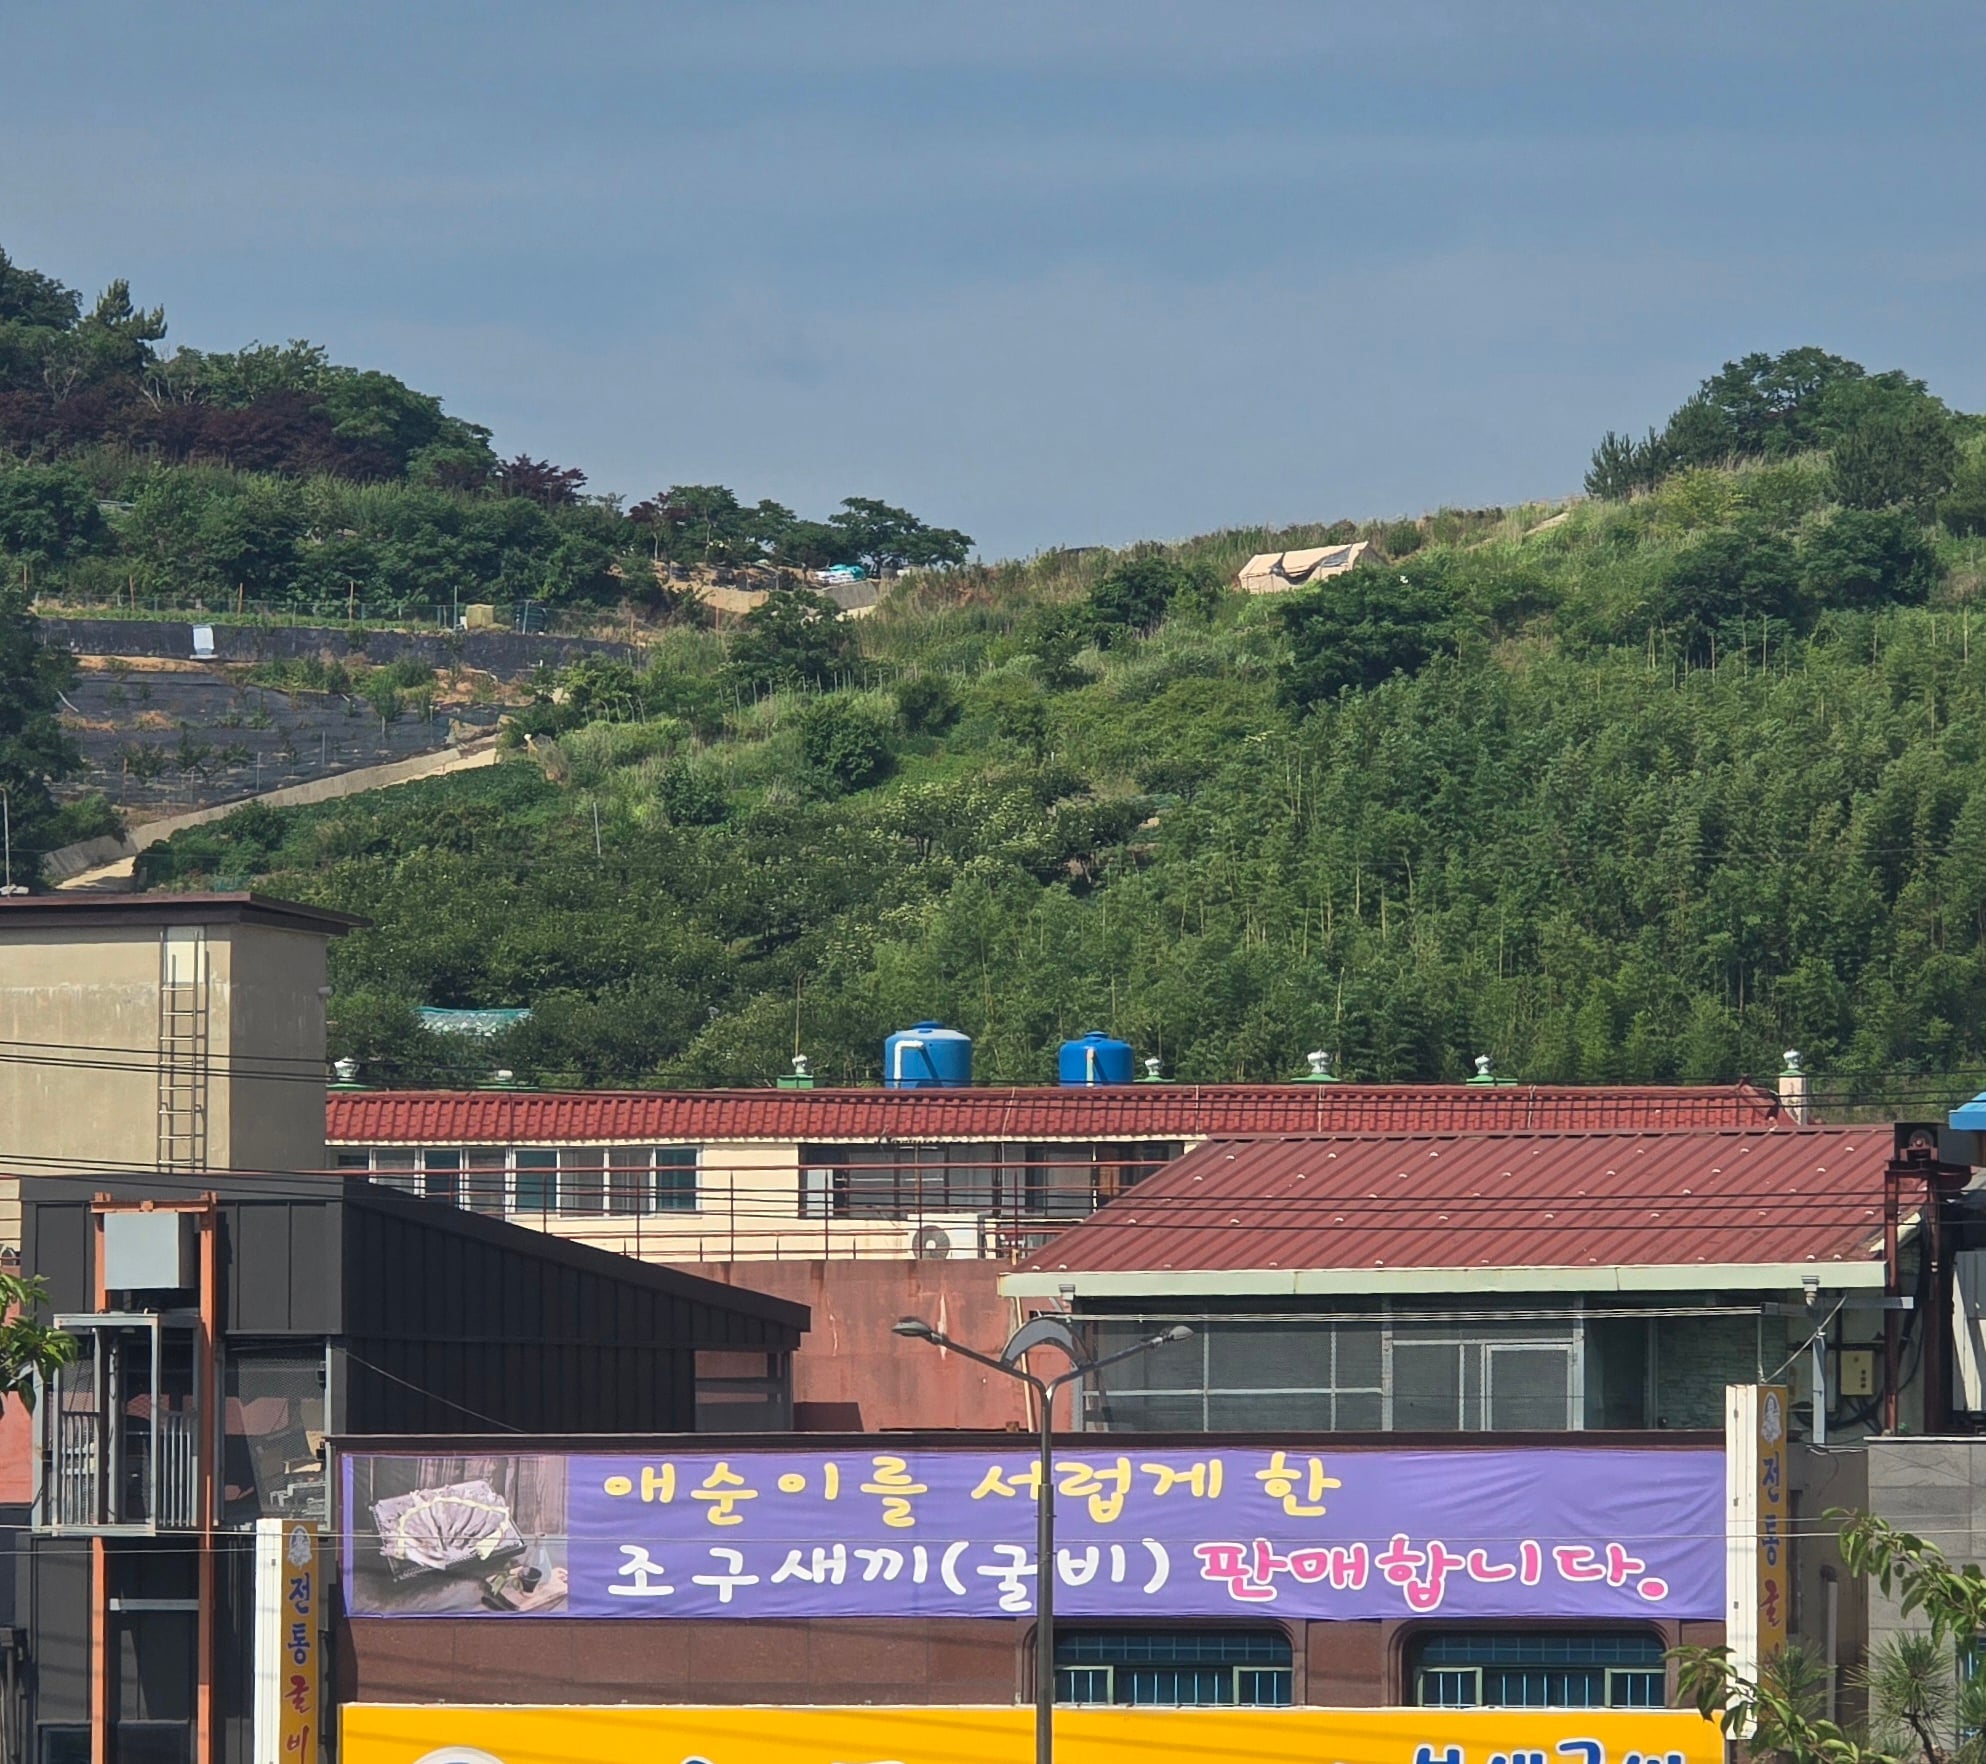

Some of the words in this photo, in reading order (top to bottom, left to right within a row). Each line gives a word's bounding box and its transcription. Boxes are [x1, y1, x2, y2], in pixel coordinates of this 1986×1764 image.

[603, 1455, 928, 1530] 애순이를
[970, 1456, 1223, 1524] 서럽게
[1254, 1452, 1341, 1517] 한
[607, 1541, 1170, 1612] 조구새끼(굴비)
[1193, 1532, 1669, 1613] 판매합니다.
